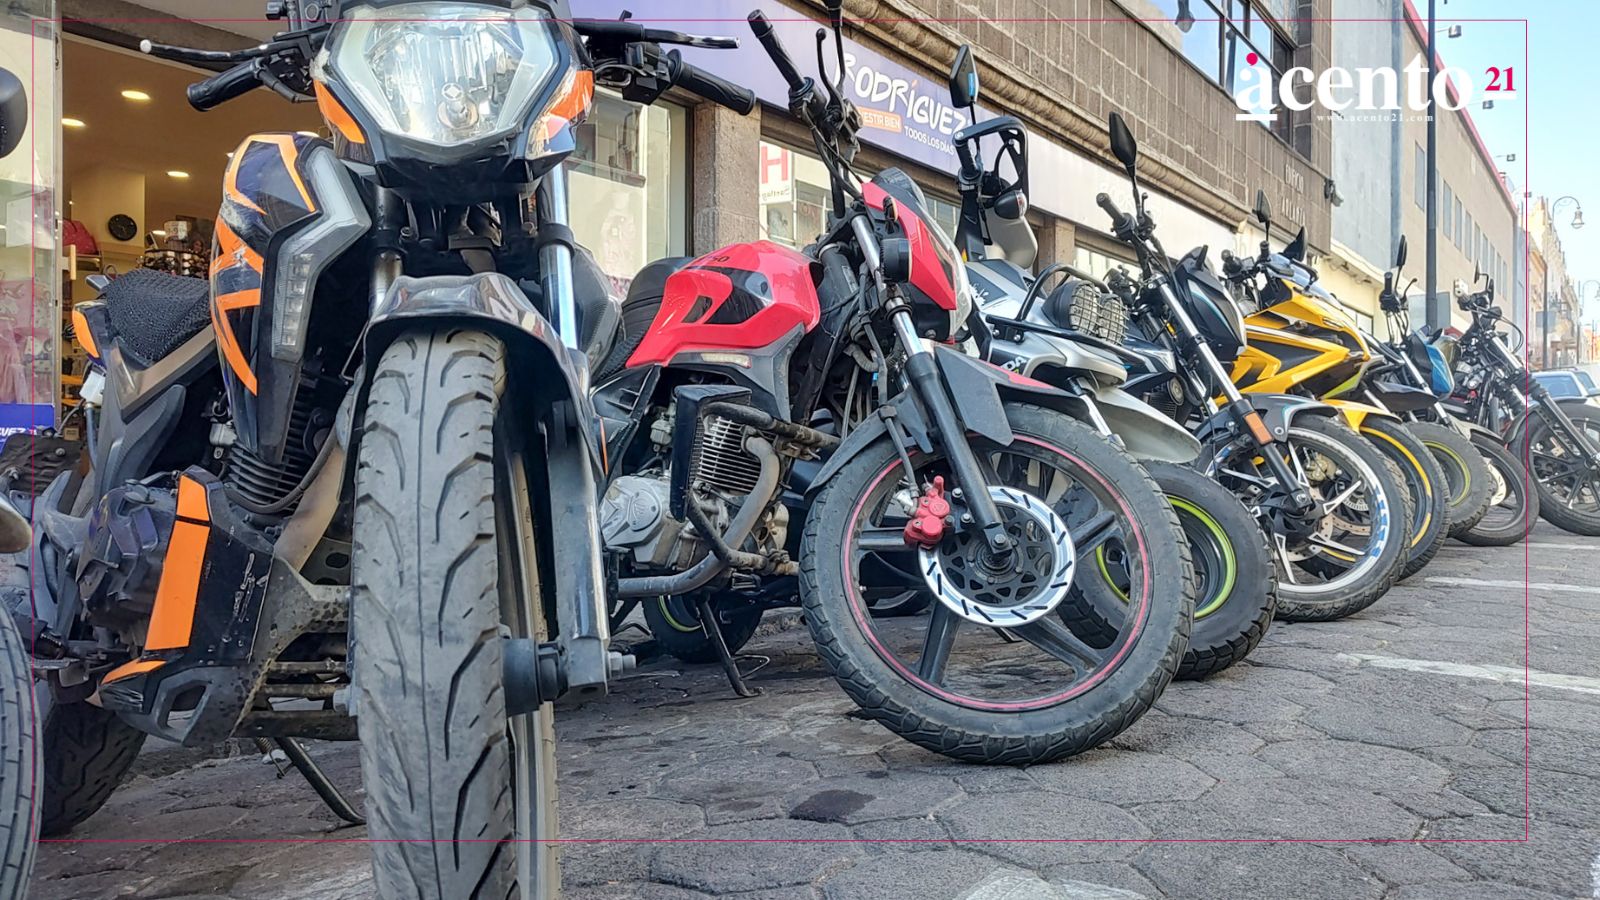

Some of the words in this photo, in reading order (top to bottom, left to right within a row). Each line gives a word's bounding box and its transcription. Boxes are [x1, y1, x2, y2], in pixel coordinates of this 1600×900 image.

[862, 111, 884, 126] ESTIR
[904, 126, 927, 144] TODOS
[927, 135, 940, 149] LOS
